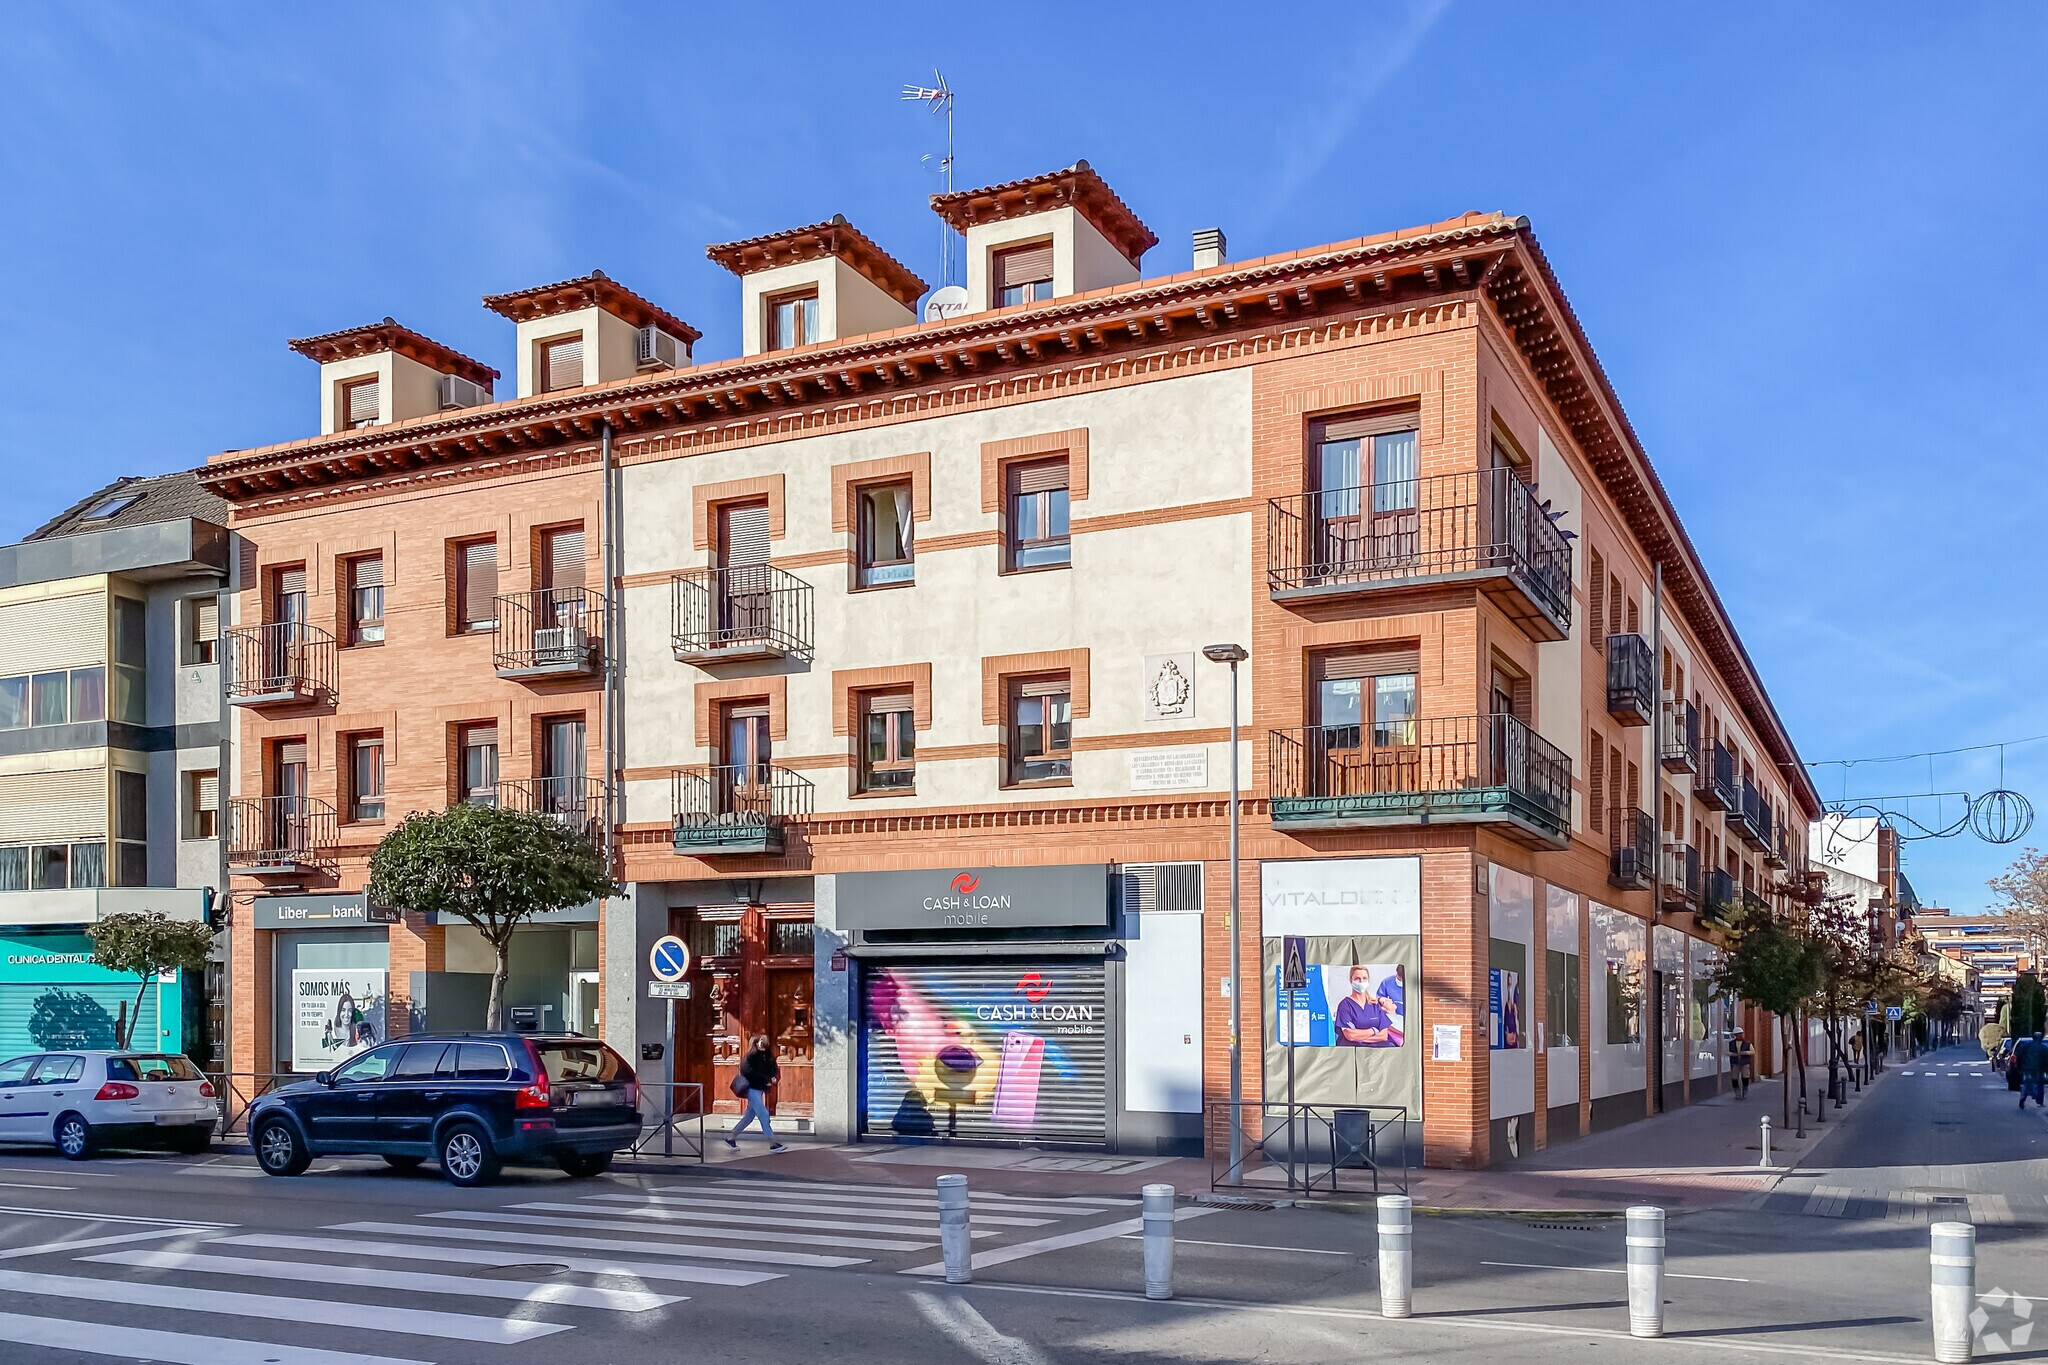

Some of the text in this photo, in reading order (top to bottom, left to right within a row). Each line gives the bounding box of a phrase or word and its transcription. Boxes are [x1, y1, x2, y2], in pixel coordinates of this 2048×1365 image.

[923, 895, 1011, 910] CASH & LOAN
[944, 911, 988, 925] mobile
[47, 954, 85, 964] DENTAL
[299, 978, 351, 996] SOMOS MÁS
[976, 1005, 1093, 1020] CASH & LOAN
[1057, 1024, 1093, 1034] mobile
